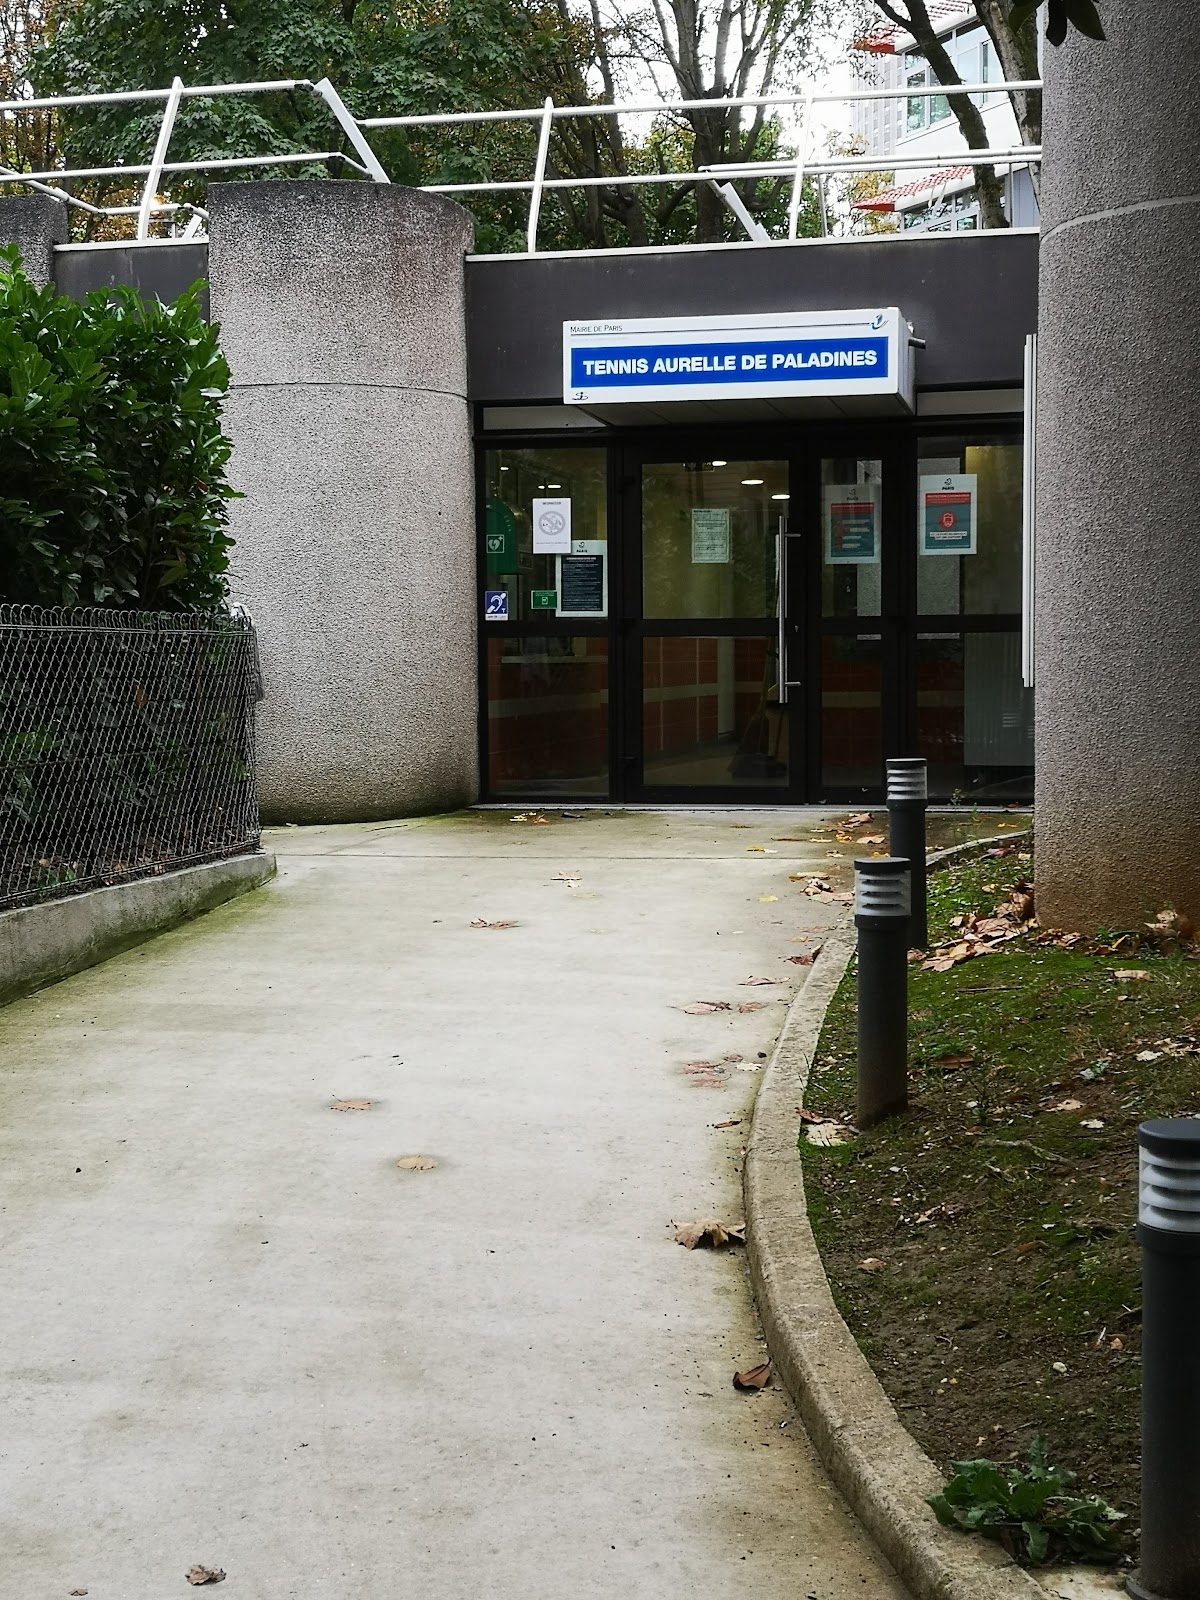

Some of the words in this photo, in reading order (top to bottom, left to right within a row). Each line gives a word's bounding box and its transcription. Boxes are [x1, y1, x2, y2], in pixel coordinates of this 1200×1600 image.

[604, 324, 623, 332] PARIS
[583, 359, 649, 376] TENNIS
[652, 356, 737, 374] AURELLE
[741, 354, 768, 371] DE
[771, 349, 878, 369] PALADINES
